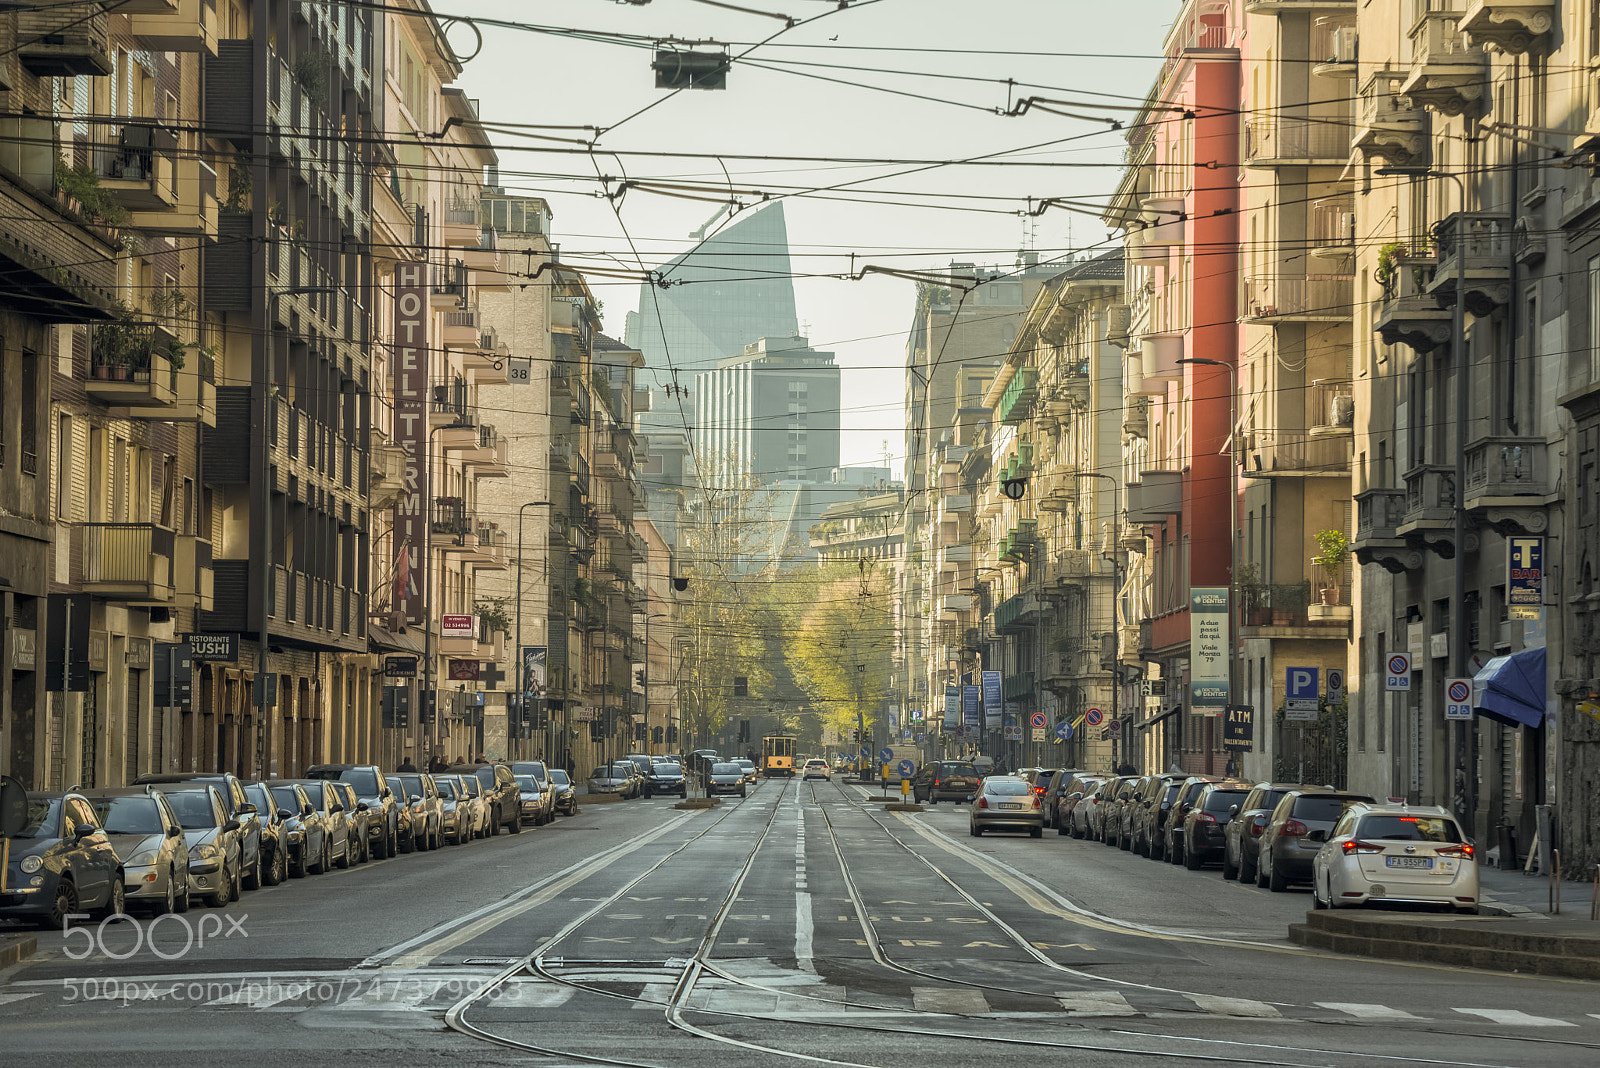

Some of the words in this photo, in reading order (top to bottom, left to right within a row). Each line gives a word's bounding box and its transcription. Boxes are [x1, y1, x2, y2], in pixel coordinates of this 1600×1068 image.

[400, 266, 421, 396] HOTEL
[511, 368, 527, 380] 38
[1512, 568, 1540, 580] BAR
[450, 662, 478, 674] BAR
[1293, 671, 1311, 695] P
[1228, 710, 1251, 723] ATM
[838, 915, 988, 923] BUS
